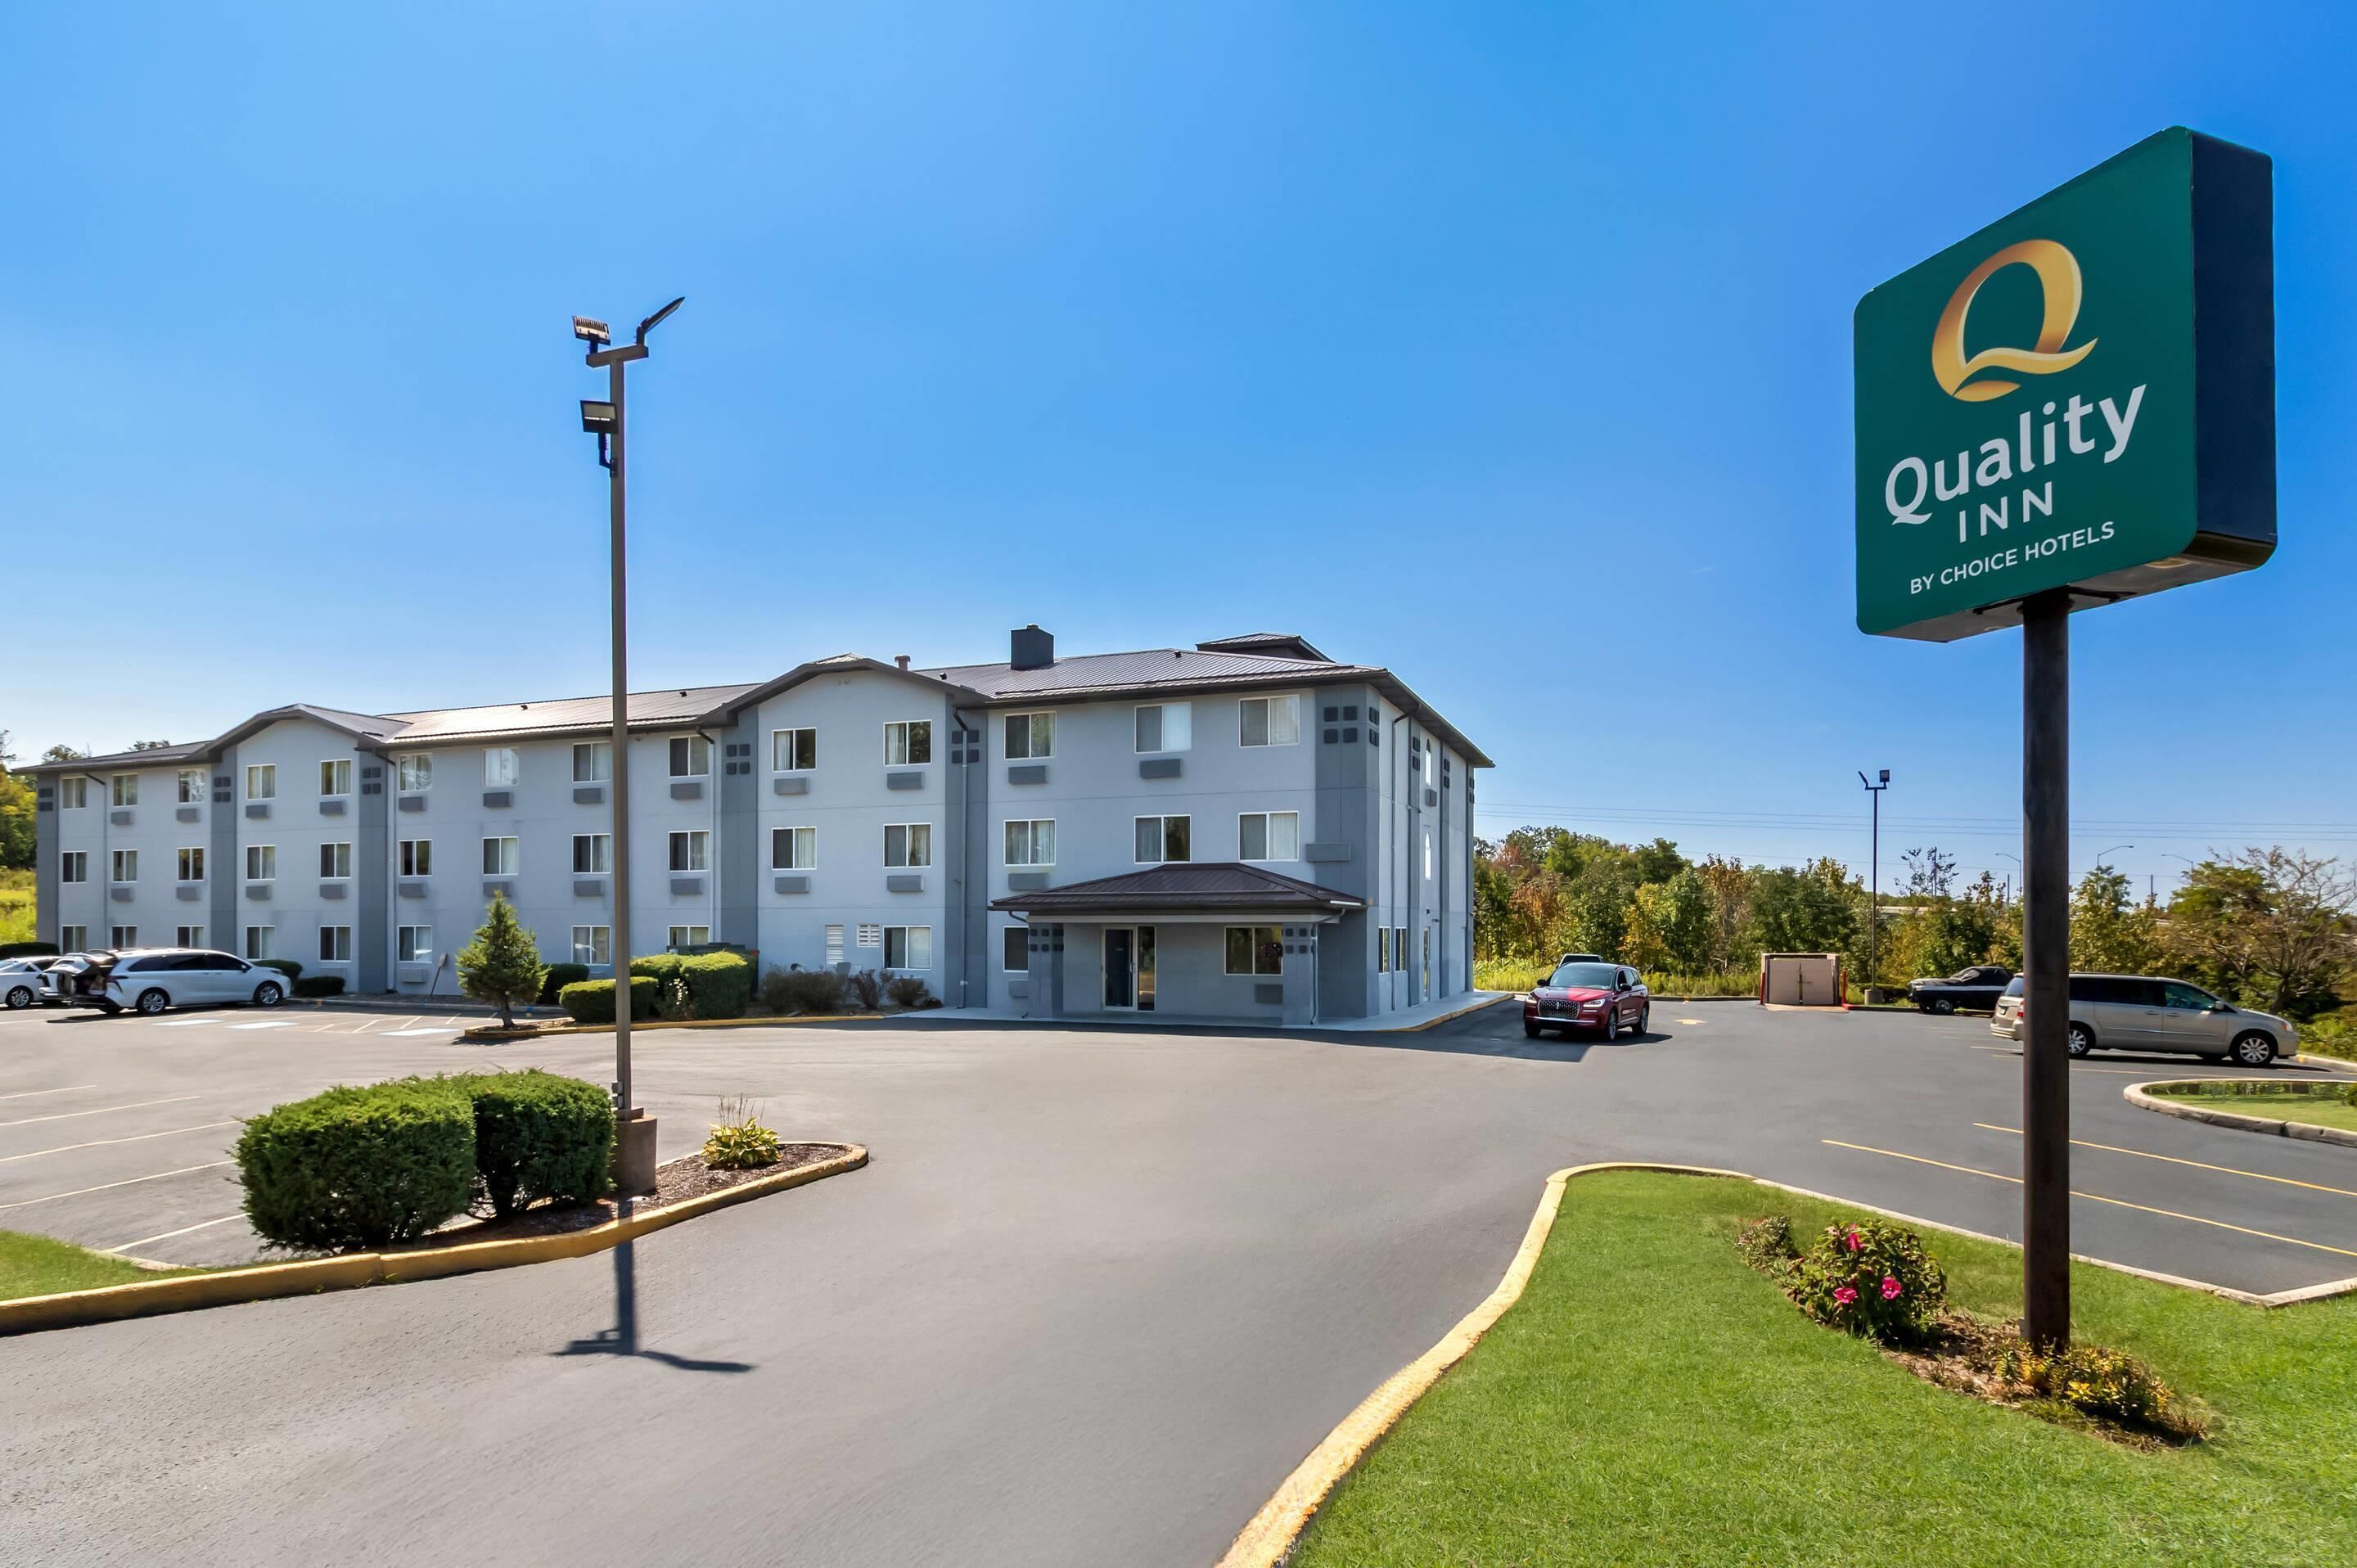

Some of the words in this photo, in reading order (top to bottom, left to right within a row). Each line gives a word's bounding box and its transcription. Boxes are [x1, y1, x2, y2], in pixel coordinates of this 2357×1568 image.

[1885, 384, 2147, 525] Quality
[1958, 481, 2053, 543] INN
[1909, 573, 1935, 595] BY
[1940, 549, 2018, 586] CHOICE
[2025, 520, 2115, 561] HOTELS
